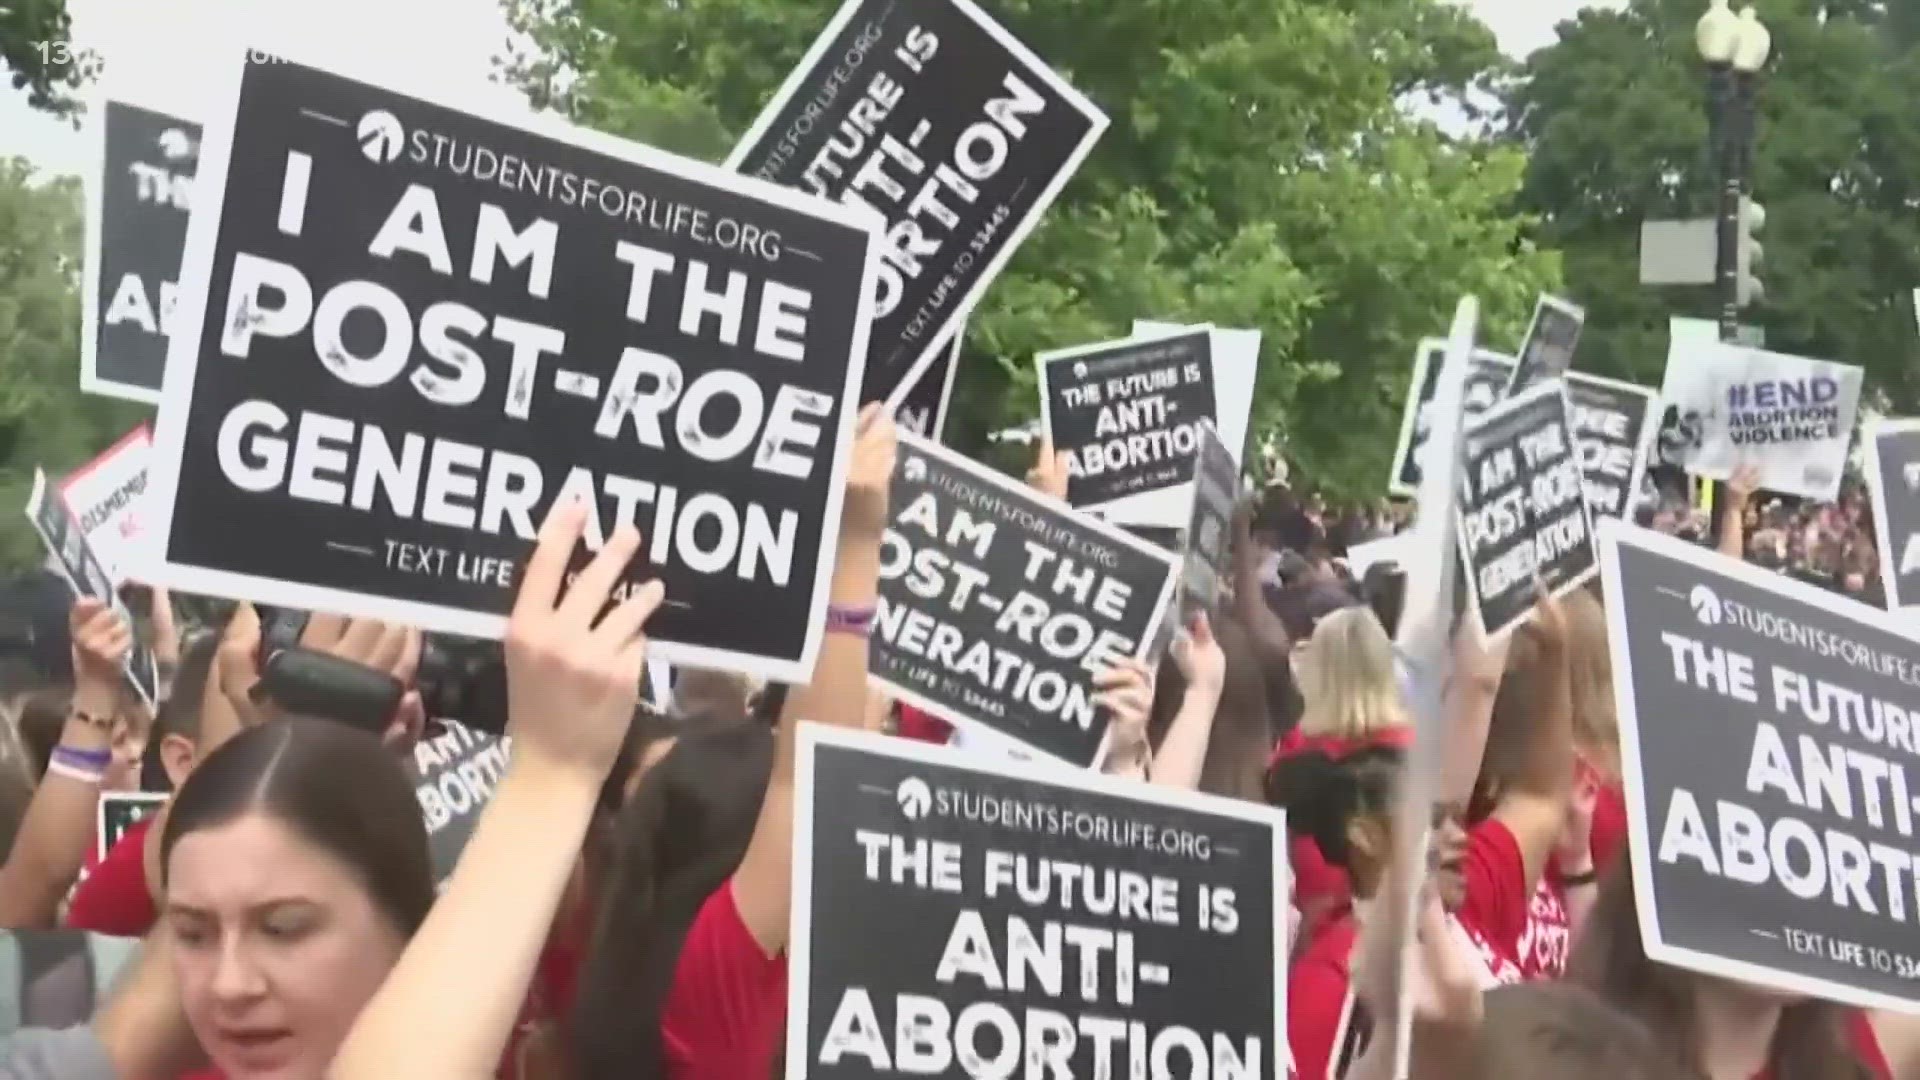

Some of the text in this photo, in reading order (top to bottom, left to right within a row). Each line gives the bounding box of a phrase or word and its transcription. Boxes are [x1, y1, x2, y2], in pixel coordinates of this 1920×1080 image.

[803, 25, 939, 198] UTURE IS
[409, 130, 782, 263] STUDENTSFORLIFE.ORG
[842, 118, 932, 206] TI-
[872, 70, 1046, 319] ORTION
[277, 149, 812, 361] I AM THE
[901, 307, 932, 342] TEXT
[928, 274, 957, 310] LIFE
[953, 251, 974, 274] TO
[220, 252, 834, 479] POST-ROE
[1061, 362, 1202, 409] THE FUTURE IS
[1729, 376, 1838, 408] #END
[1095, 395, 1178, 437] ANTI-
[1729, 405, 1838, 428] ABORTION
[1730, 423, 1838, 446] VIOLENCE
[217, 400, 798, 588] GENERATION
[384, 539, 515, 588] TEXT LIFE
[879, 529, 1135, 673] OST-ROE
[897, 492, 1133, 621] AM THE
[872, 595, 1096, 730] NERATION
[1661, 631, 1758, 703] THE
[936, 785, 1211, 860] STUDENTSFORLIFE.ORG
[856, 829, 1240, 934] THE FUTURE IS
[936, 908, 1170, 1006] ANTI-
[1784, 927, 1823, 958] TEXT
[1829, 937, 1866, 968] LIFE
[1868, 948, 1892, 974] TO
[818, 987, 1262, 1080] ABORTION
